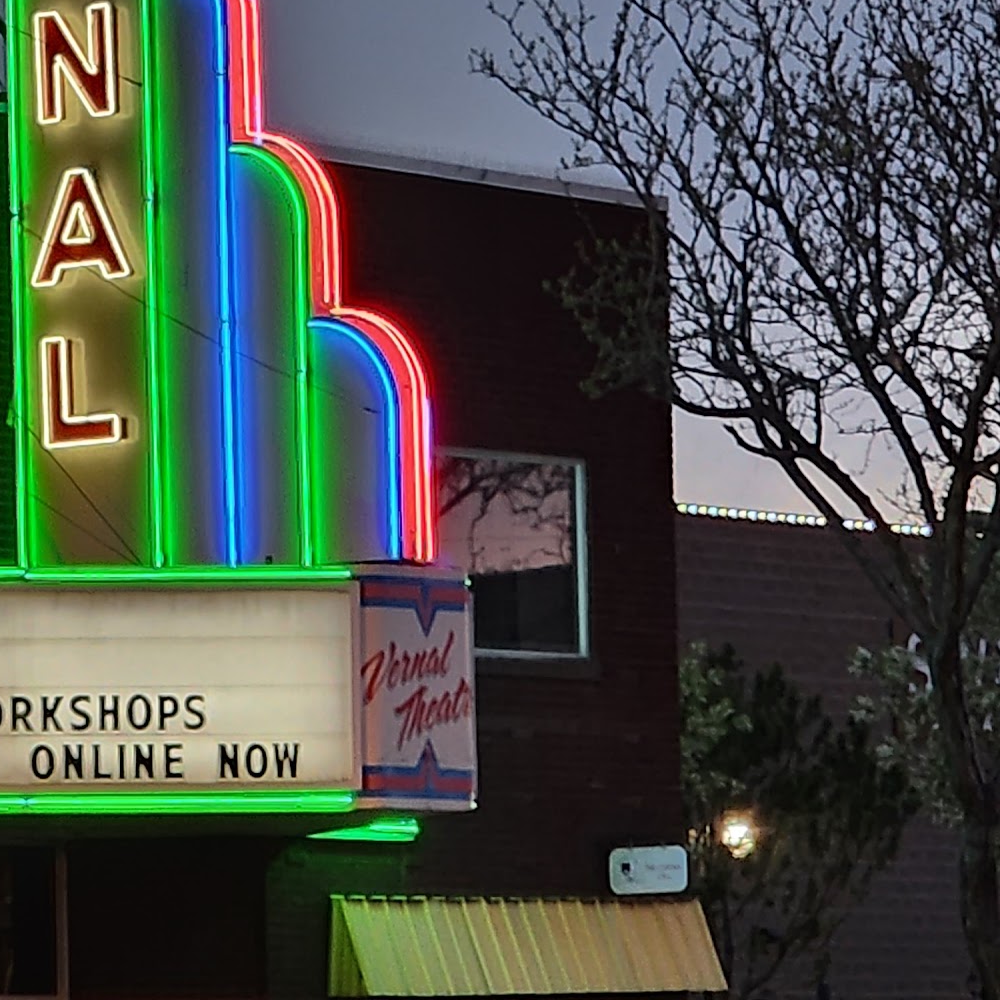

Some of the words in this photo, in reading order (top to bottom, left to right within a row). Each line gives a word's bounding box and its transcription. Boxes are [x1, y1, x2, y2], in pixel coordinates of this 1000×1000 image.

[360, 630, 454, 706] Vernal
[31, 743, 184, 779] ONLINE
[219, 742, 300, 778] NOW
